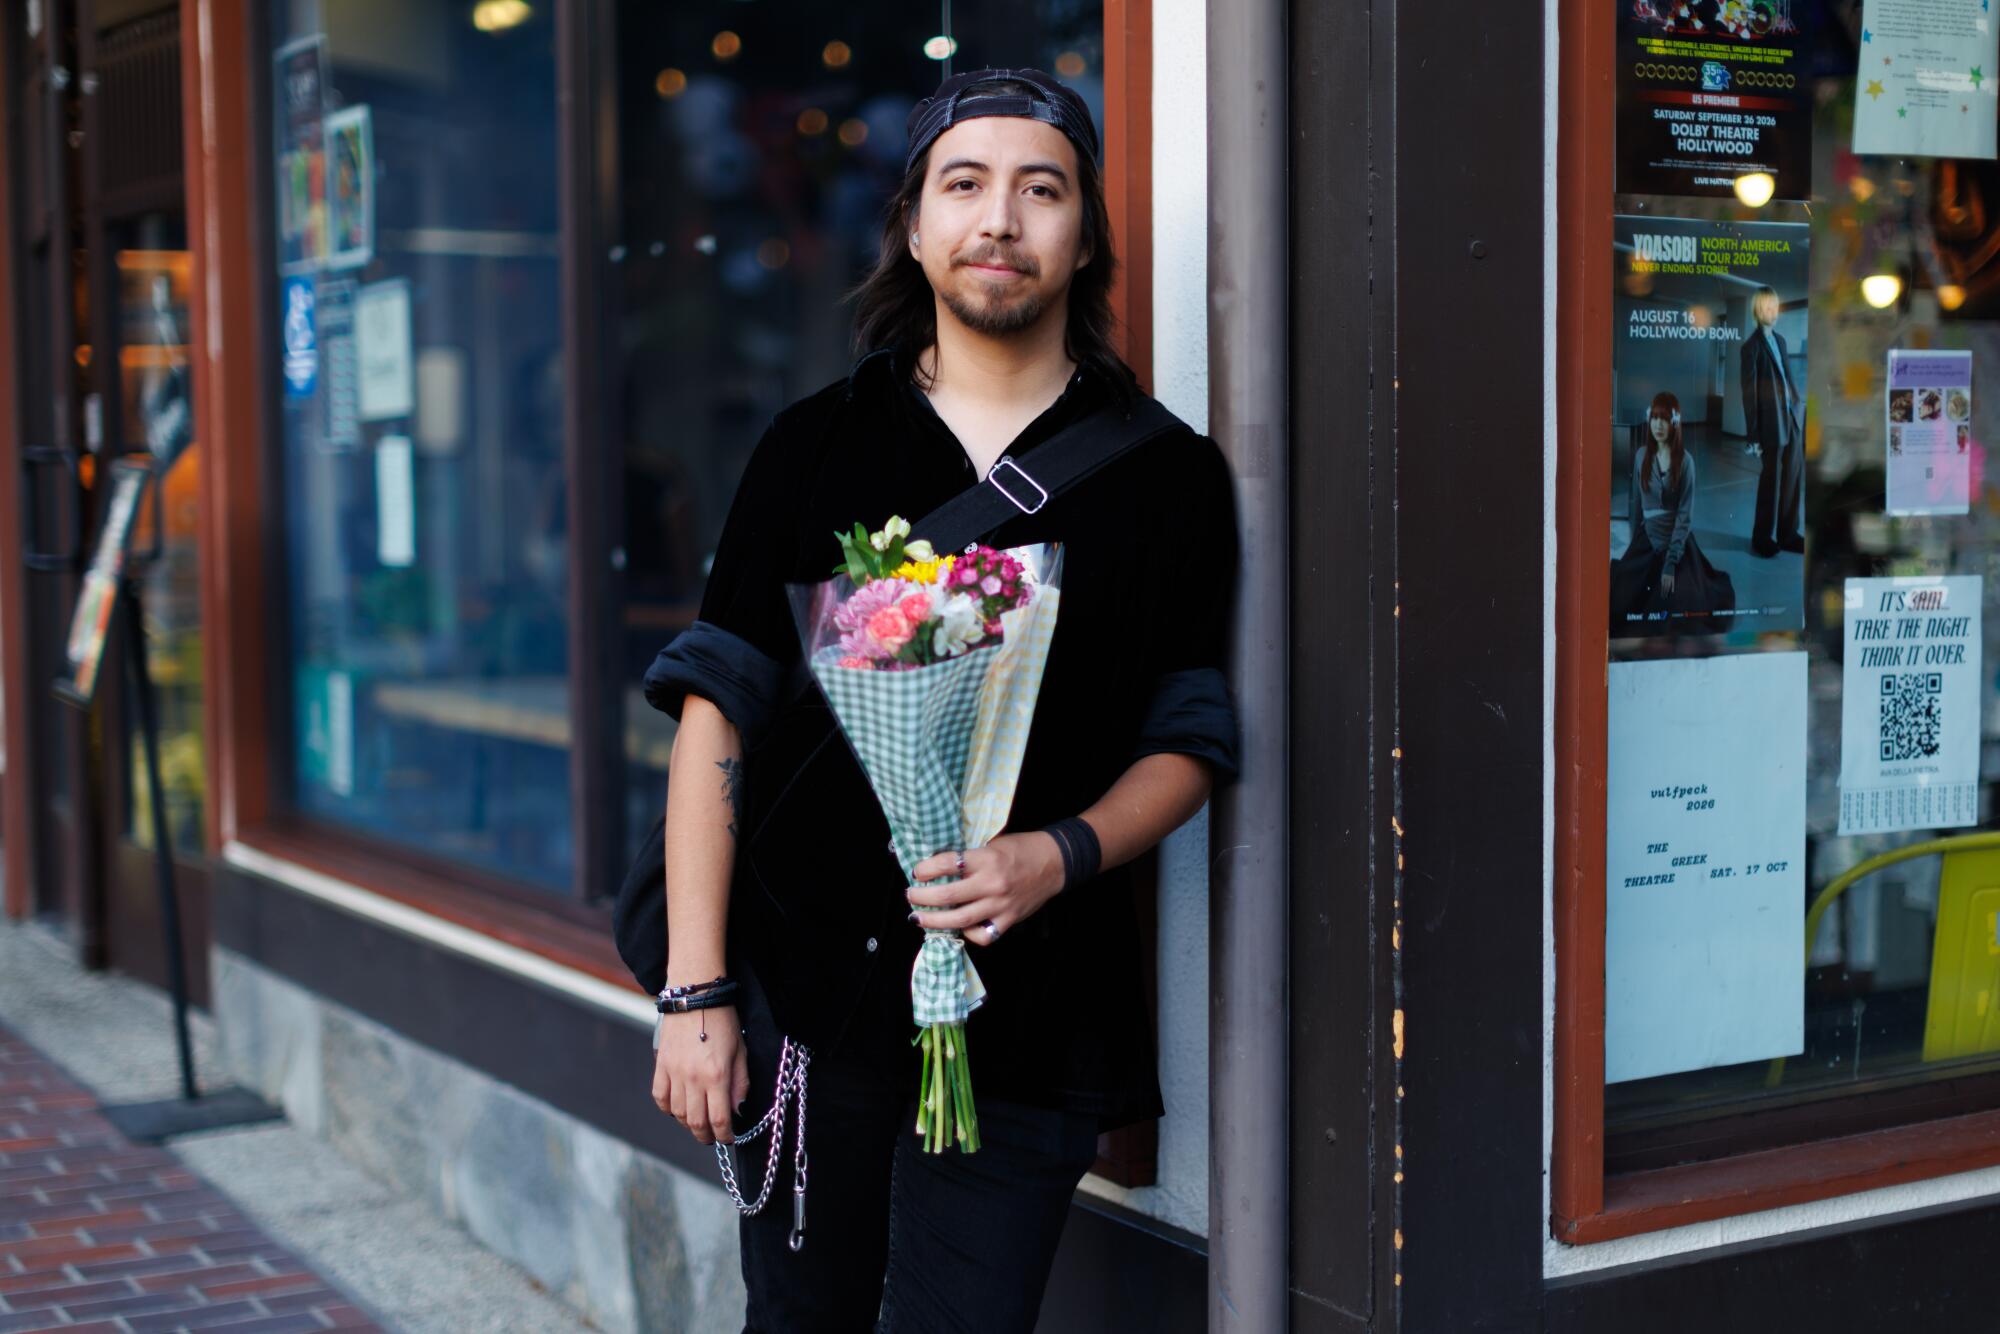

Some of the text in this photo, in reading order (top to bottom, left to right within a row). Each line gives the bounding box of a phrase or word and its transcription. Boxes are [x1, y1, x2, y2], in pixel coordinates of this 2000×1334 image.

[1692, 94, 1740, 107] US PREMIERE
[1654, 109, 1776, 126] SATURDAY SEPTEMBER 26 2026
[1671, 123, 1760, 140] DOLBY THEATRE
[1677, 138, 1753, 154] HOLLYWOOD
[1694, 177, 1708, 185] LIVE
[1633, 234, 1790, 263] YOASOBI NORTH AMERICA
[1702, 252, 1759, 265] TOUR 2026
[1632, 262, 1729, 274] NEVER ENDING STORIES
[1630, 310, 1696, 323] AUGUST 16
[1630, 325, 1741, 340] HOLLYWOOD BOWL
[1880, 591, 1906, 612] IT'S
[1854, 616, 1971, 640] TAKE THE NIGHT.
[1861, 644, 1966, 668] THINK IT OVER.
[1651, 784, 1708, 799] vulfpeck
[1686, 799, 1715, 811] 2026
[1647, 843, 1669, 855] THE
[1671, 854, 1708, 867] GREEK
[1710, 862, 1788, 878] SAT. 17 OCT
[1624, 873, 1676, 888] THEATRE
